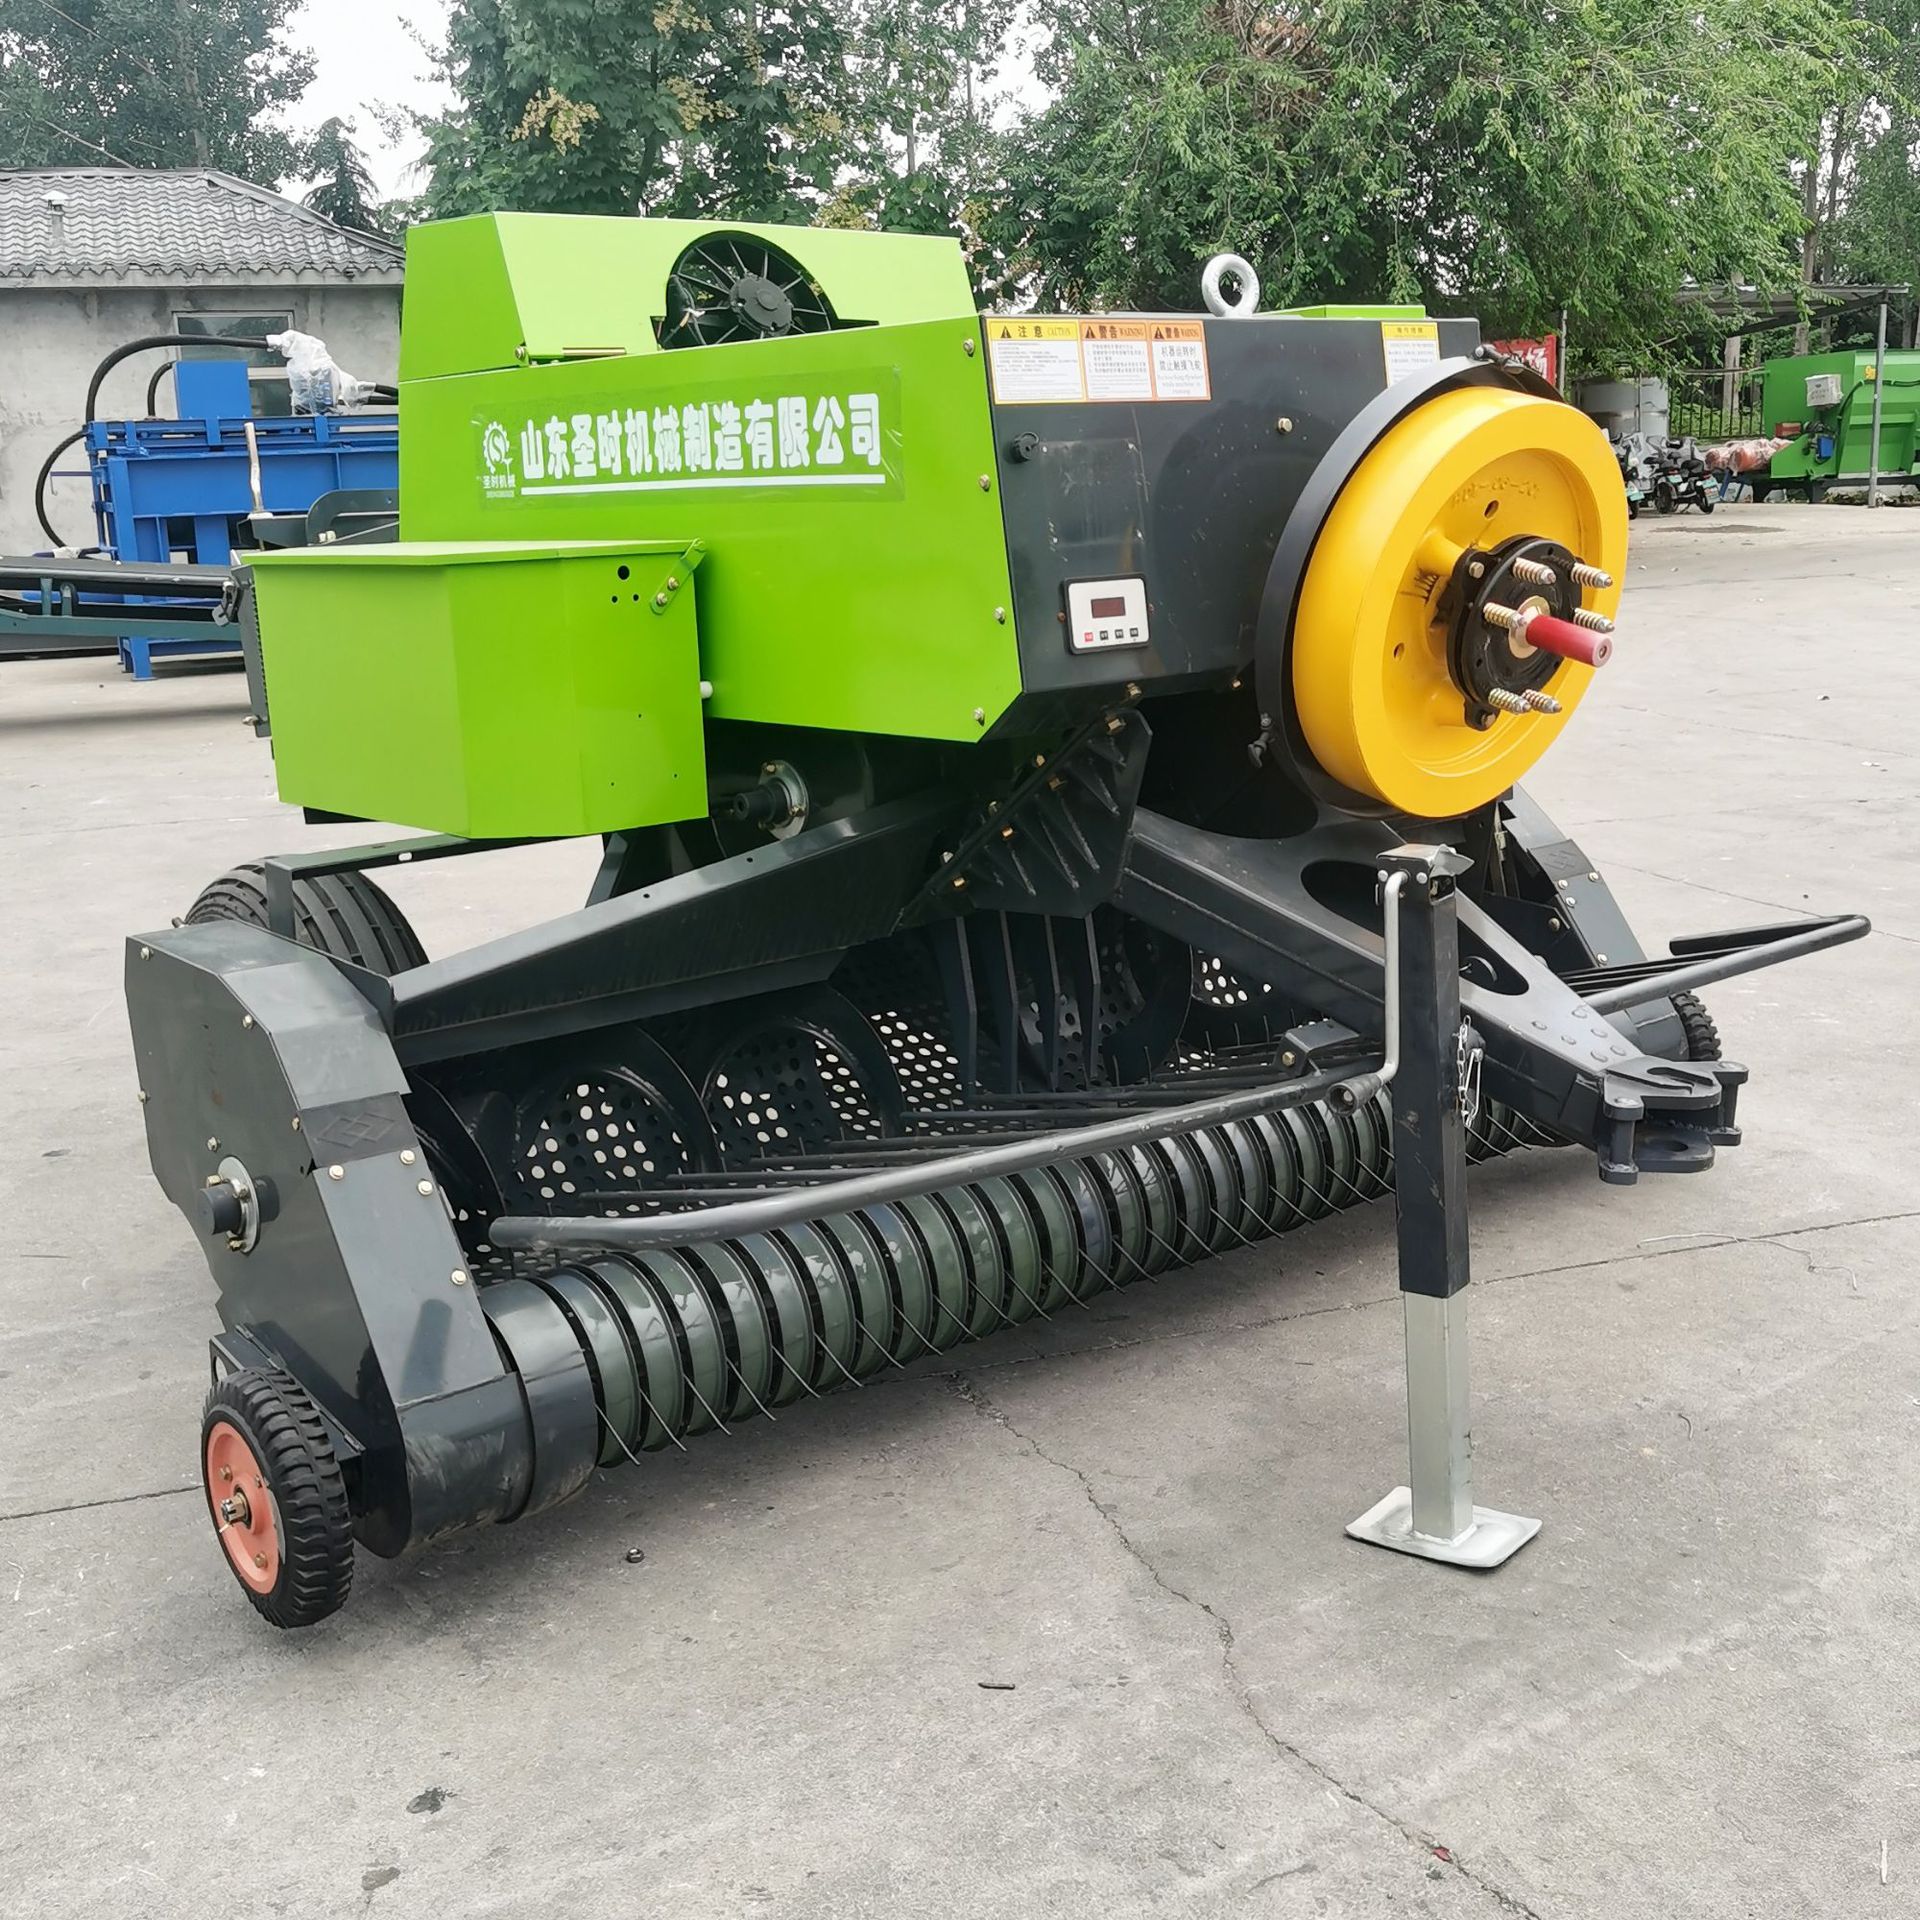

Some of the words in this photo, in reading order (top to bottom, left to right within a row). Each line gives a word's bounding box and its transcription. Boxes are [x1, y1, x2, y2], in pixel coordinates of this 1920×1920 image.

[1018, 325, 1043, 338] 注意
[1098, 325, 1117, 339] 警告
[1119, 327, 1144, 337] WARNING
[520, 392, 881, 480] 山东圣时机械制造有限公司
